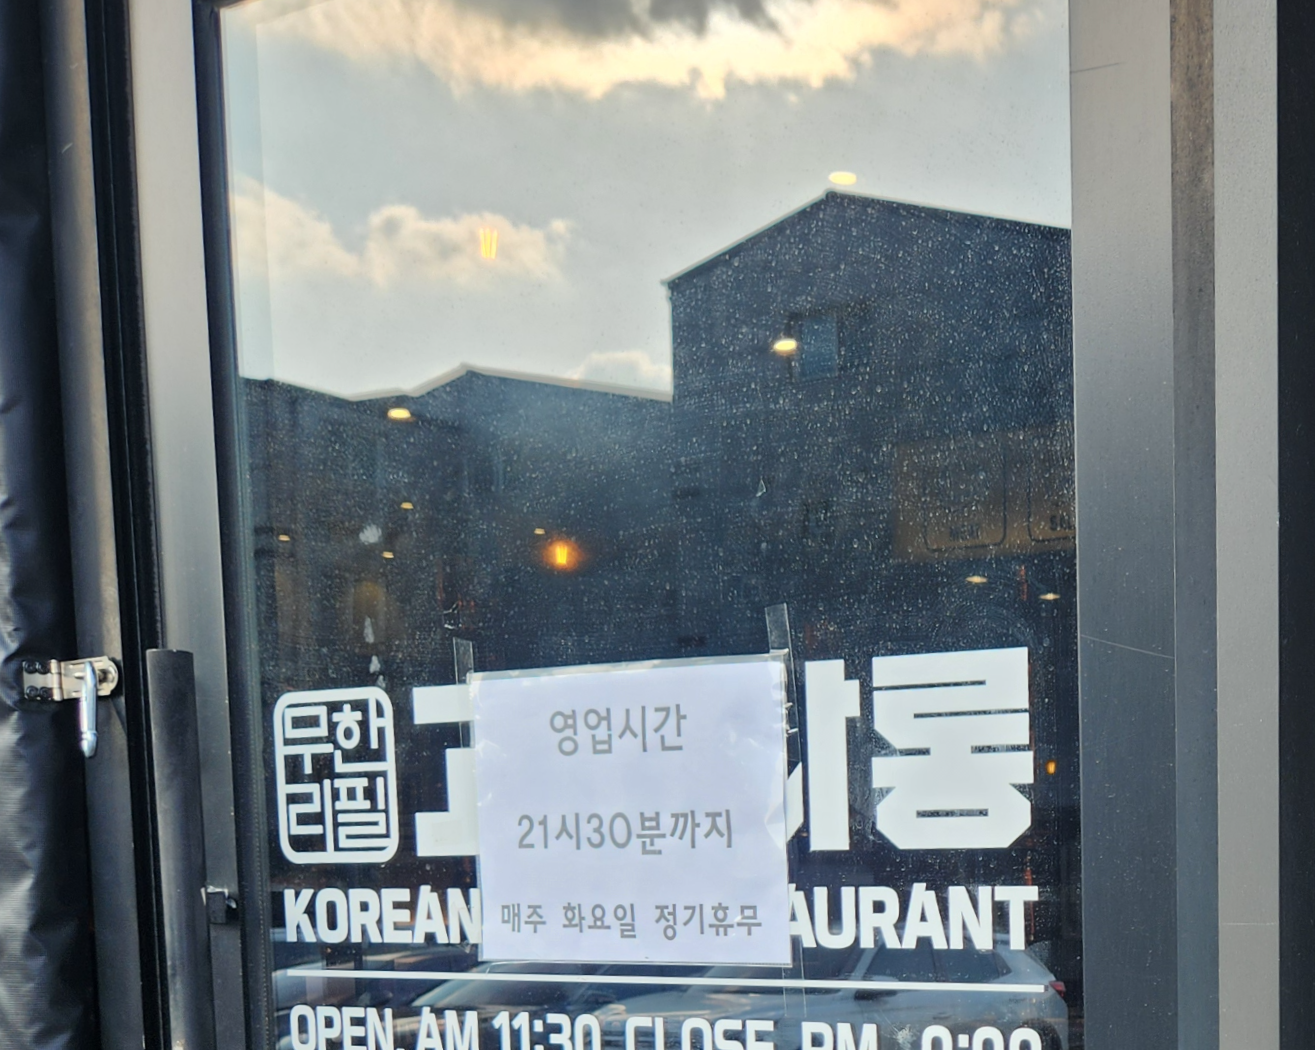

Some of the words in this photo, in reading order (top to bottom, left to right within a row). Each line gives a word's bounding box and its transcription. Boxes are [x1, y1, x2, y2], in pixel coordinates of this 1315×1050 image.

[284, 703, 393, 774] 무한
[549, 703, 687, 756] 영업시간
[284, 776, 393, 852] 리필
[517, 809, 733, 855] 21시30분까지
[283, 885, 482, 944] KOREAN
[789, 883, 1038, 950] AURANT
[501, 902, 546, 933] 매주
[562, 902, 637, 939] 화요일
[654, 902, 762, 940] 정기휴무
